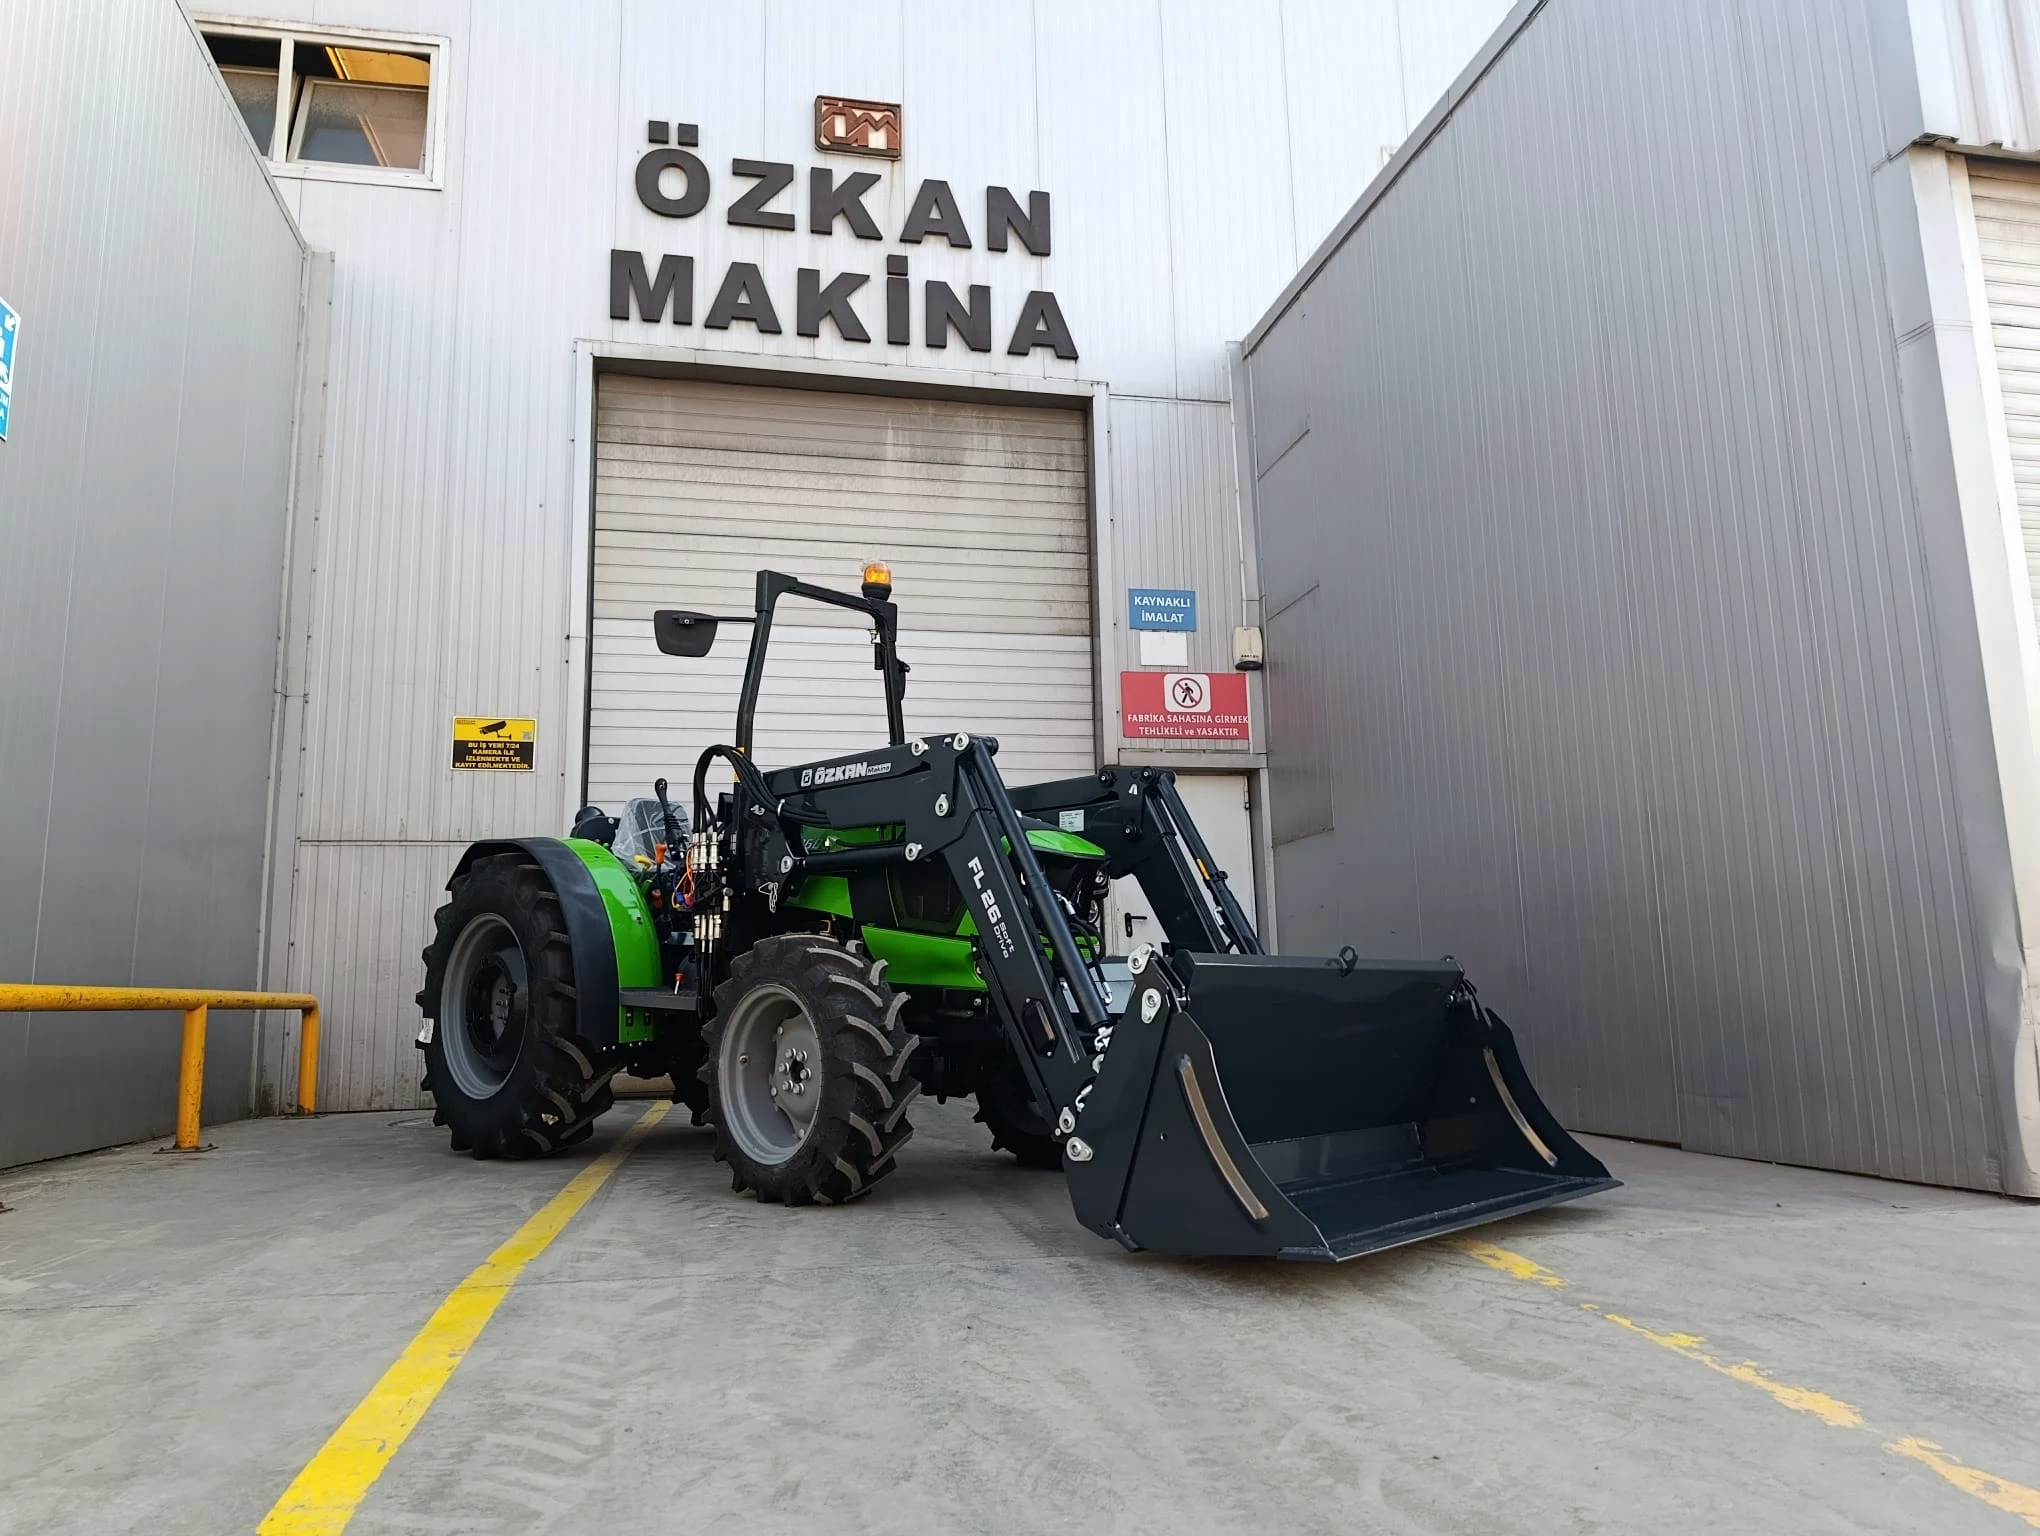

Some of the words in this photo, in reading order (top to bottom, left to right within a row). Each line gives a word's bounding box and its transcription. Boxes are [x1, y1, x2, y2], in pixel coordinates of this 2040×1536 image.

[635, 120, 1051, 256] ÖZKAN
[609, 249, 1079, 360] MAKİNA
[1134, 595, 1190, 608] KAYNAKLI
[1141, 610, 1184, 623] İMALAT
[1127, 713, 1165, 723] FABRİKA
[1167, 714, 1212, 724] SAHASINA
[1214, 713, 1249, 724] GİRMEK
[1139, 725, 1182, 736] TEHLİKELİ
[1184, 728, 1194, 736] ve
[1196, 727, 1239, 736] YASAKTIR
[815, 762, 868, 785] ÖZKAN
[968, 856, 984, 890] FL
[980, 889, 1001, 924] 26
